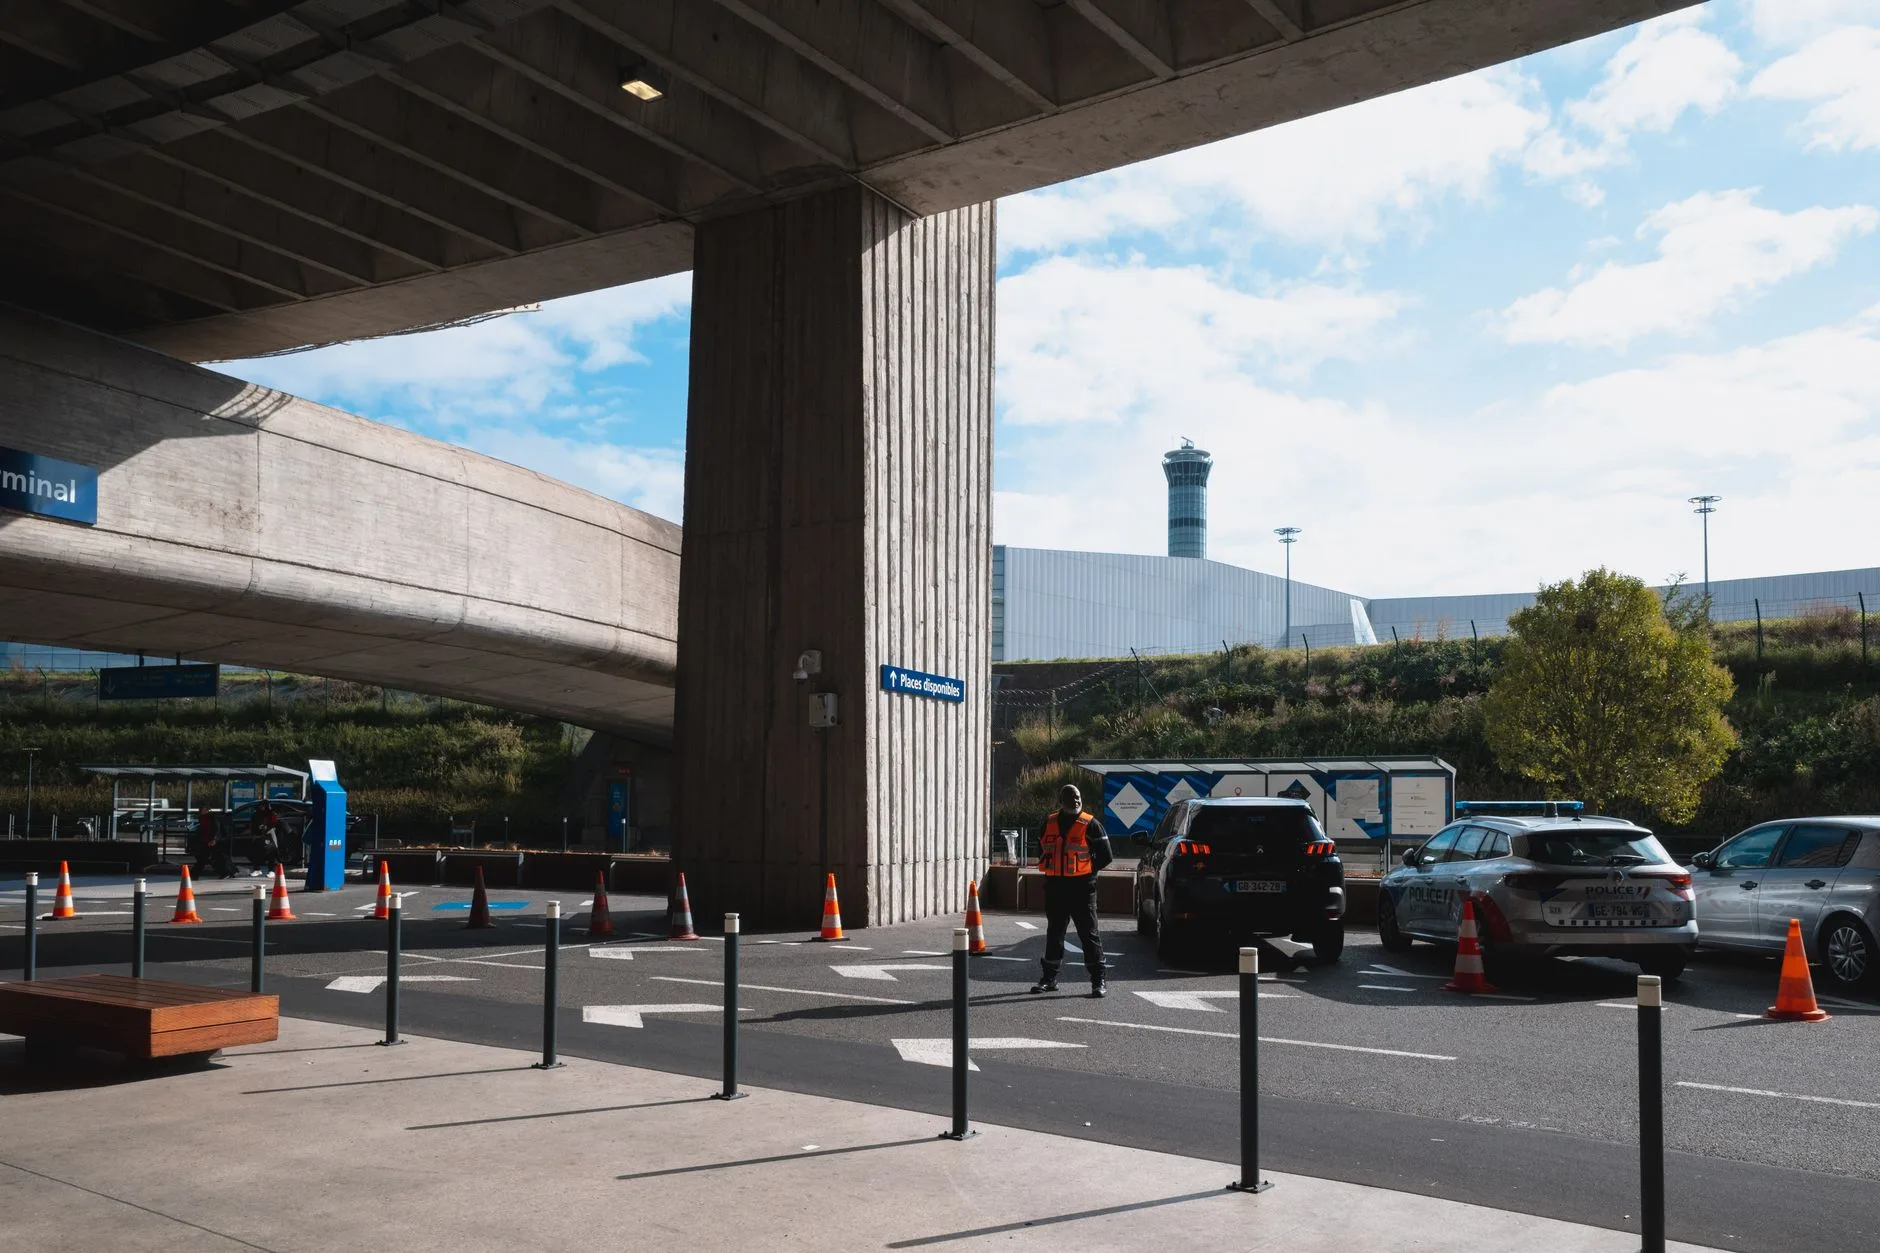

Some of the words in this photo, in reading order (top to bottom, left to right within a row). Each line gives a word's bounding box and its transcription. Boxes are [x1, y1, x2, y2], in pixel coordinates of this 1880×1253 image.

[0, 470, 76, 503] minal
[900, 674, 922, 690] Places
[923, 678, 960, 697] disponibles
[1409, 886, 1442, 904] POLICE
[1585, 886, 1634, 895] POLICE
